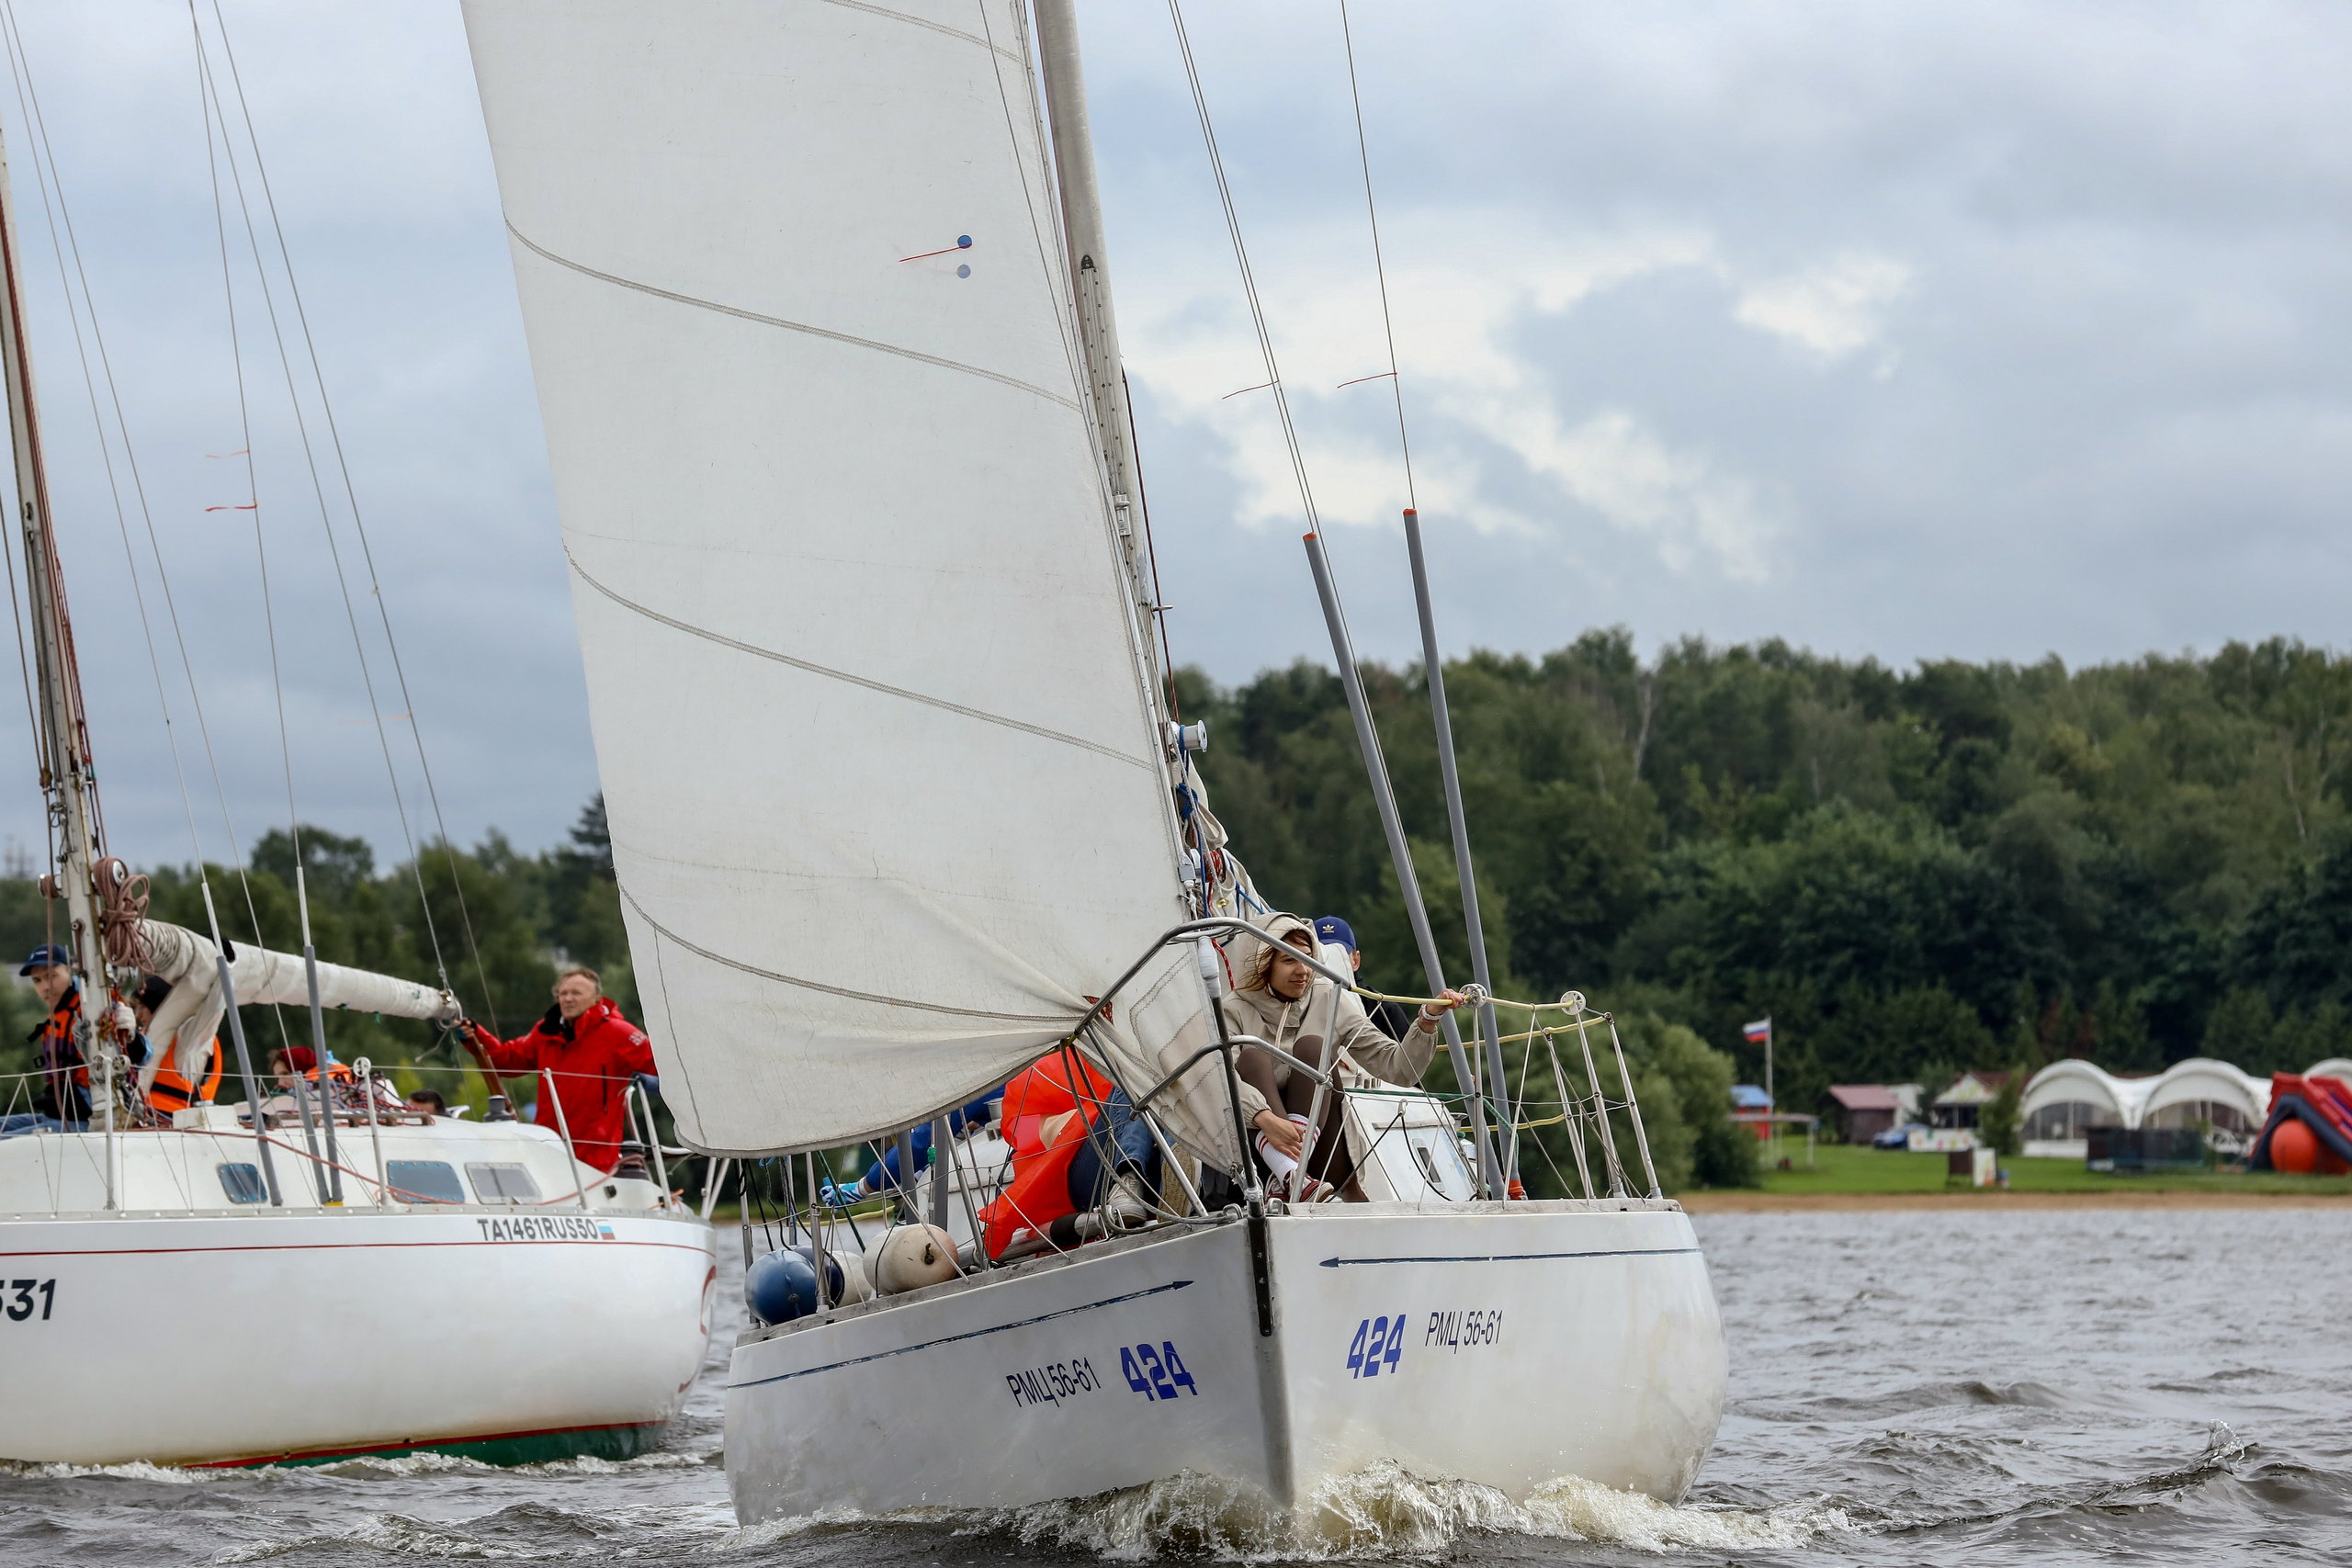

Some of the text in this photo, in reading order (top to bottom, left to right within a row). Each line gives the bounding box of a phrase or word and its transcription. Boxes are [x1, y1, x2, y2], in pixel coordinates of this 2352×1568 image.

[477, 1217, 597, 1241] TA1461RUS50
[0, 1279, 56, 1321] 31
[1346, 1314, 1407, 1379] 424
[1425, 1309, 1503, 1355] РМЦ 56-61
[1119, 1340, 1198, 1402] 424
